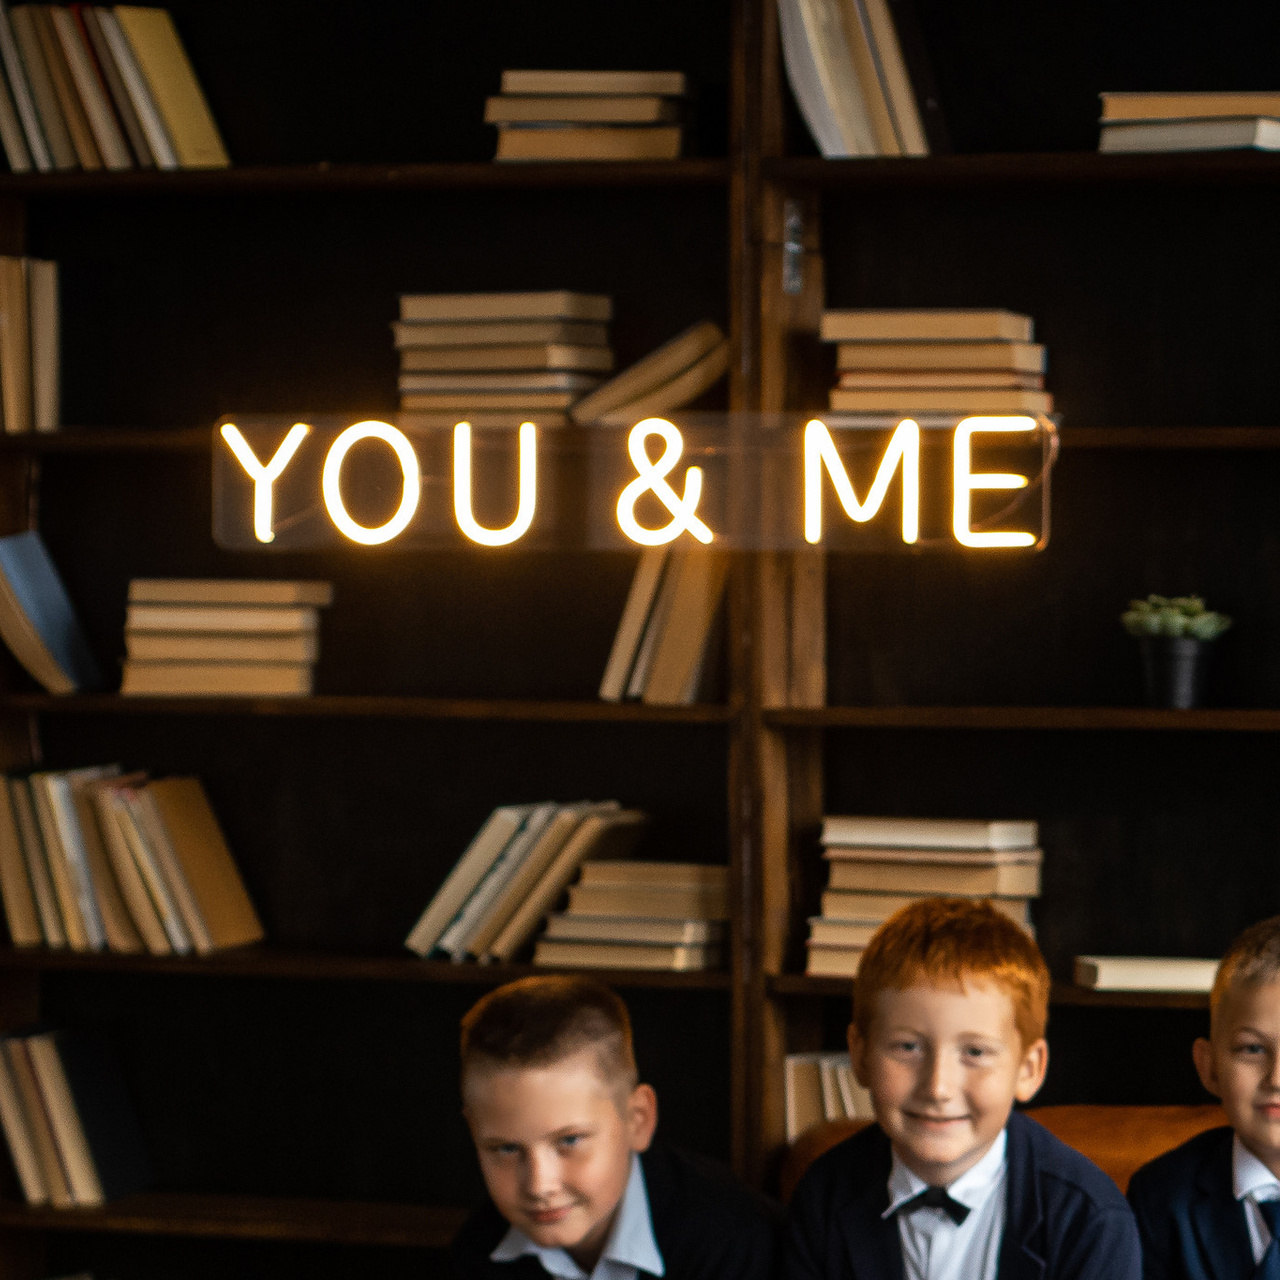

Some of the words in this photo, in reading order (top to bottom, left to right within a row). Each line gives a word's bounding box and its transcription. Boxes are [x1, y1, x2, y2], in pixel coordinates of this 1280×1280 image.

[219, 419, 538, 547] YOU
[615, 416, 715, 547] &
[802, 415, 1039, 549] ME
